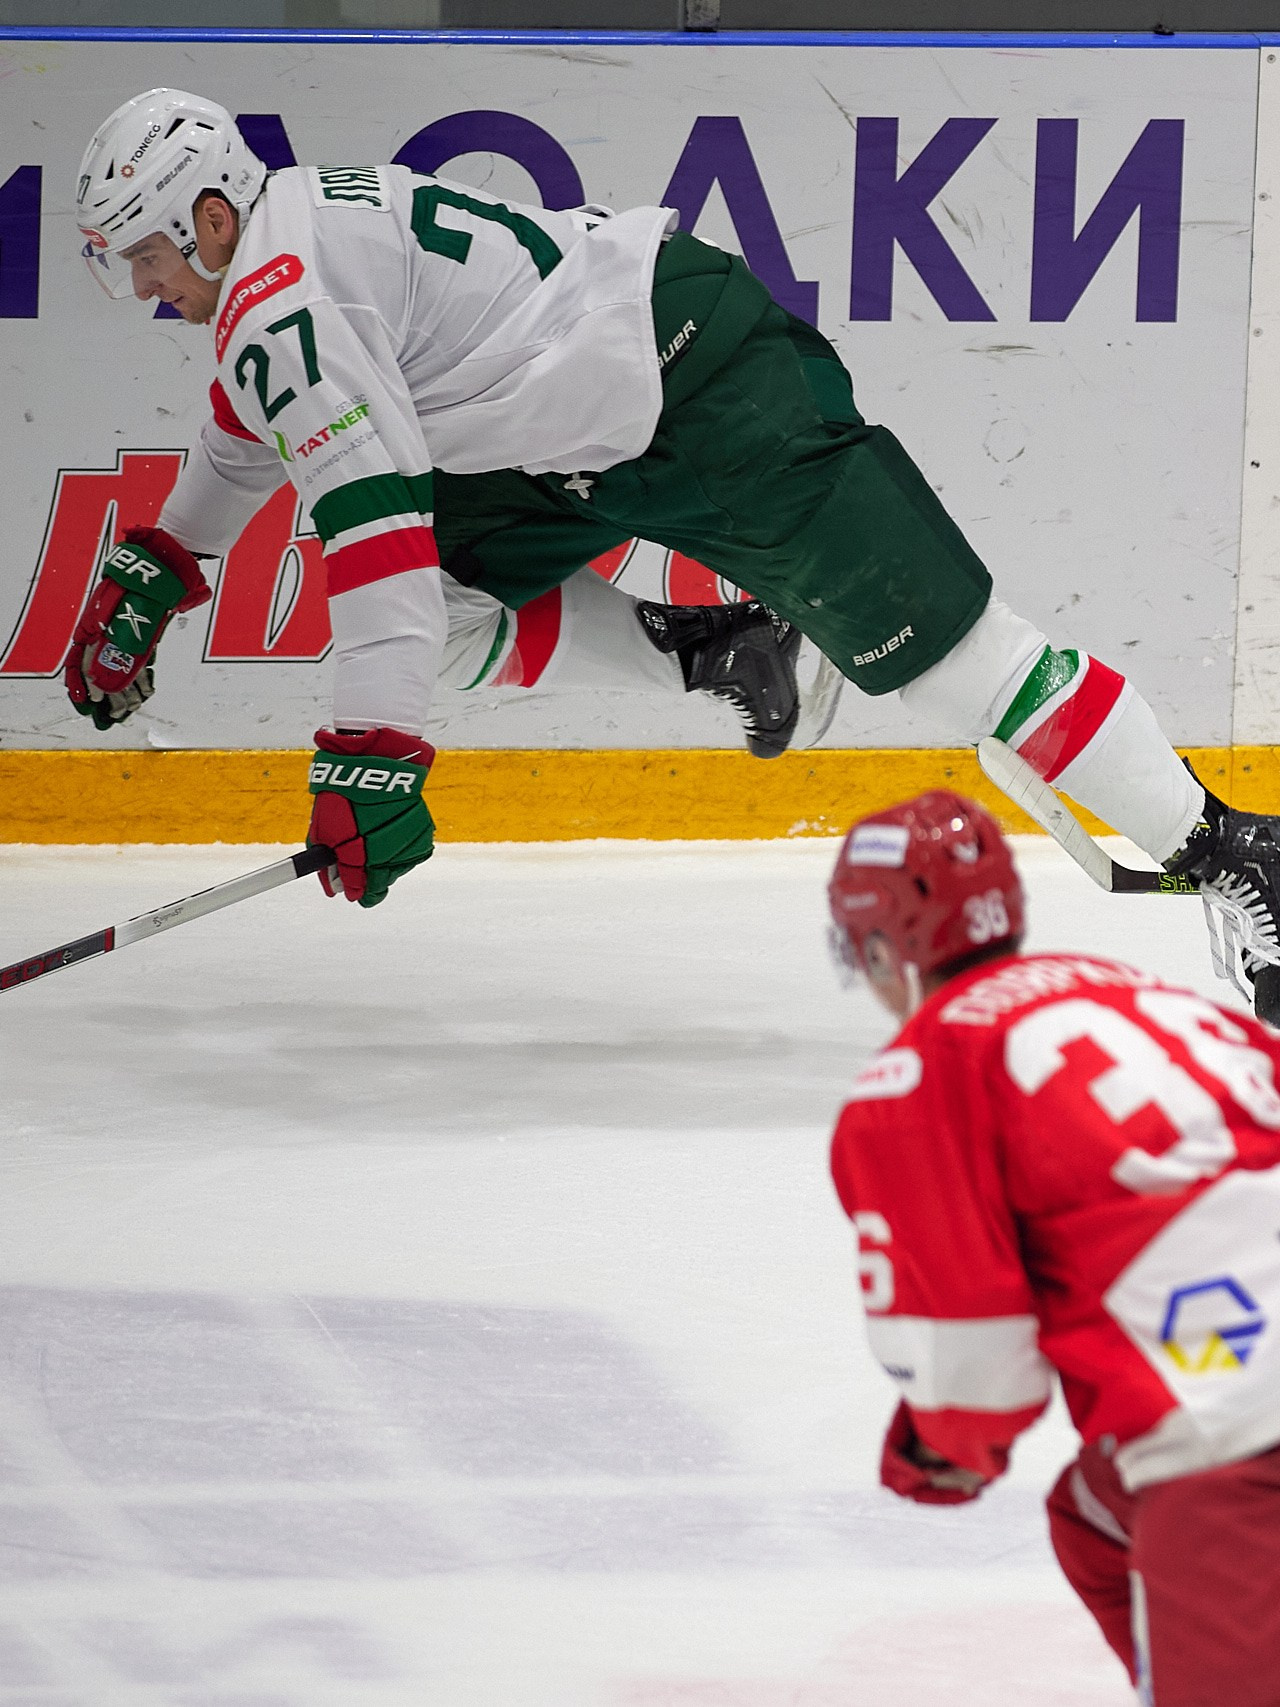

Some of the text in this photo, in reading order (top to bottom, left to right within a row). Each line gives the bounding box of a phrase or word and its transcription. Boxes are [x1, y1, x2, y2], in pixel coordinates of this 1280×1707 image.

[234, 307, 323, 425] 27
[853, 624, 915, 667] BAUER
[308, 762, 417, 794] AUER
